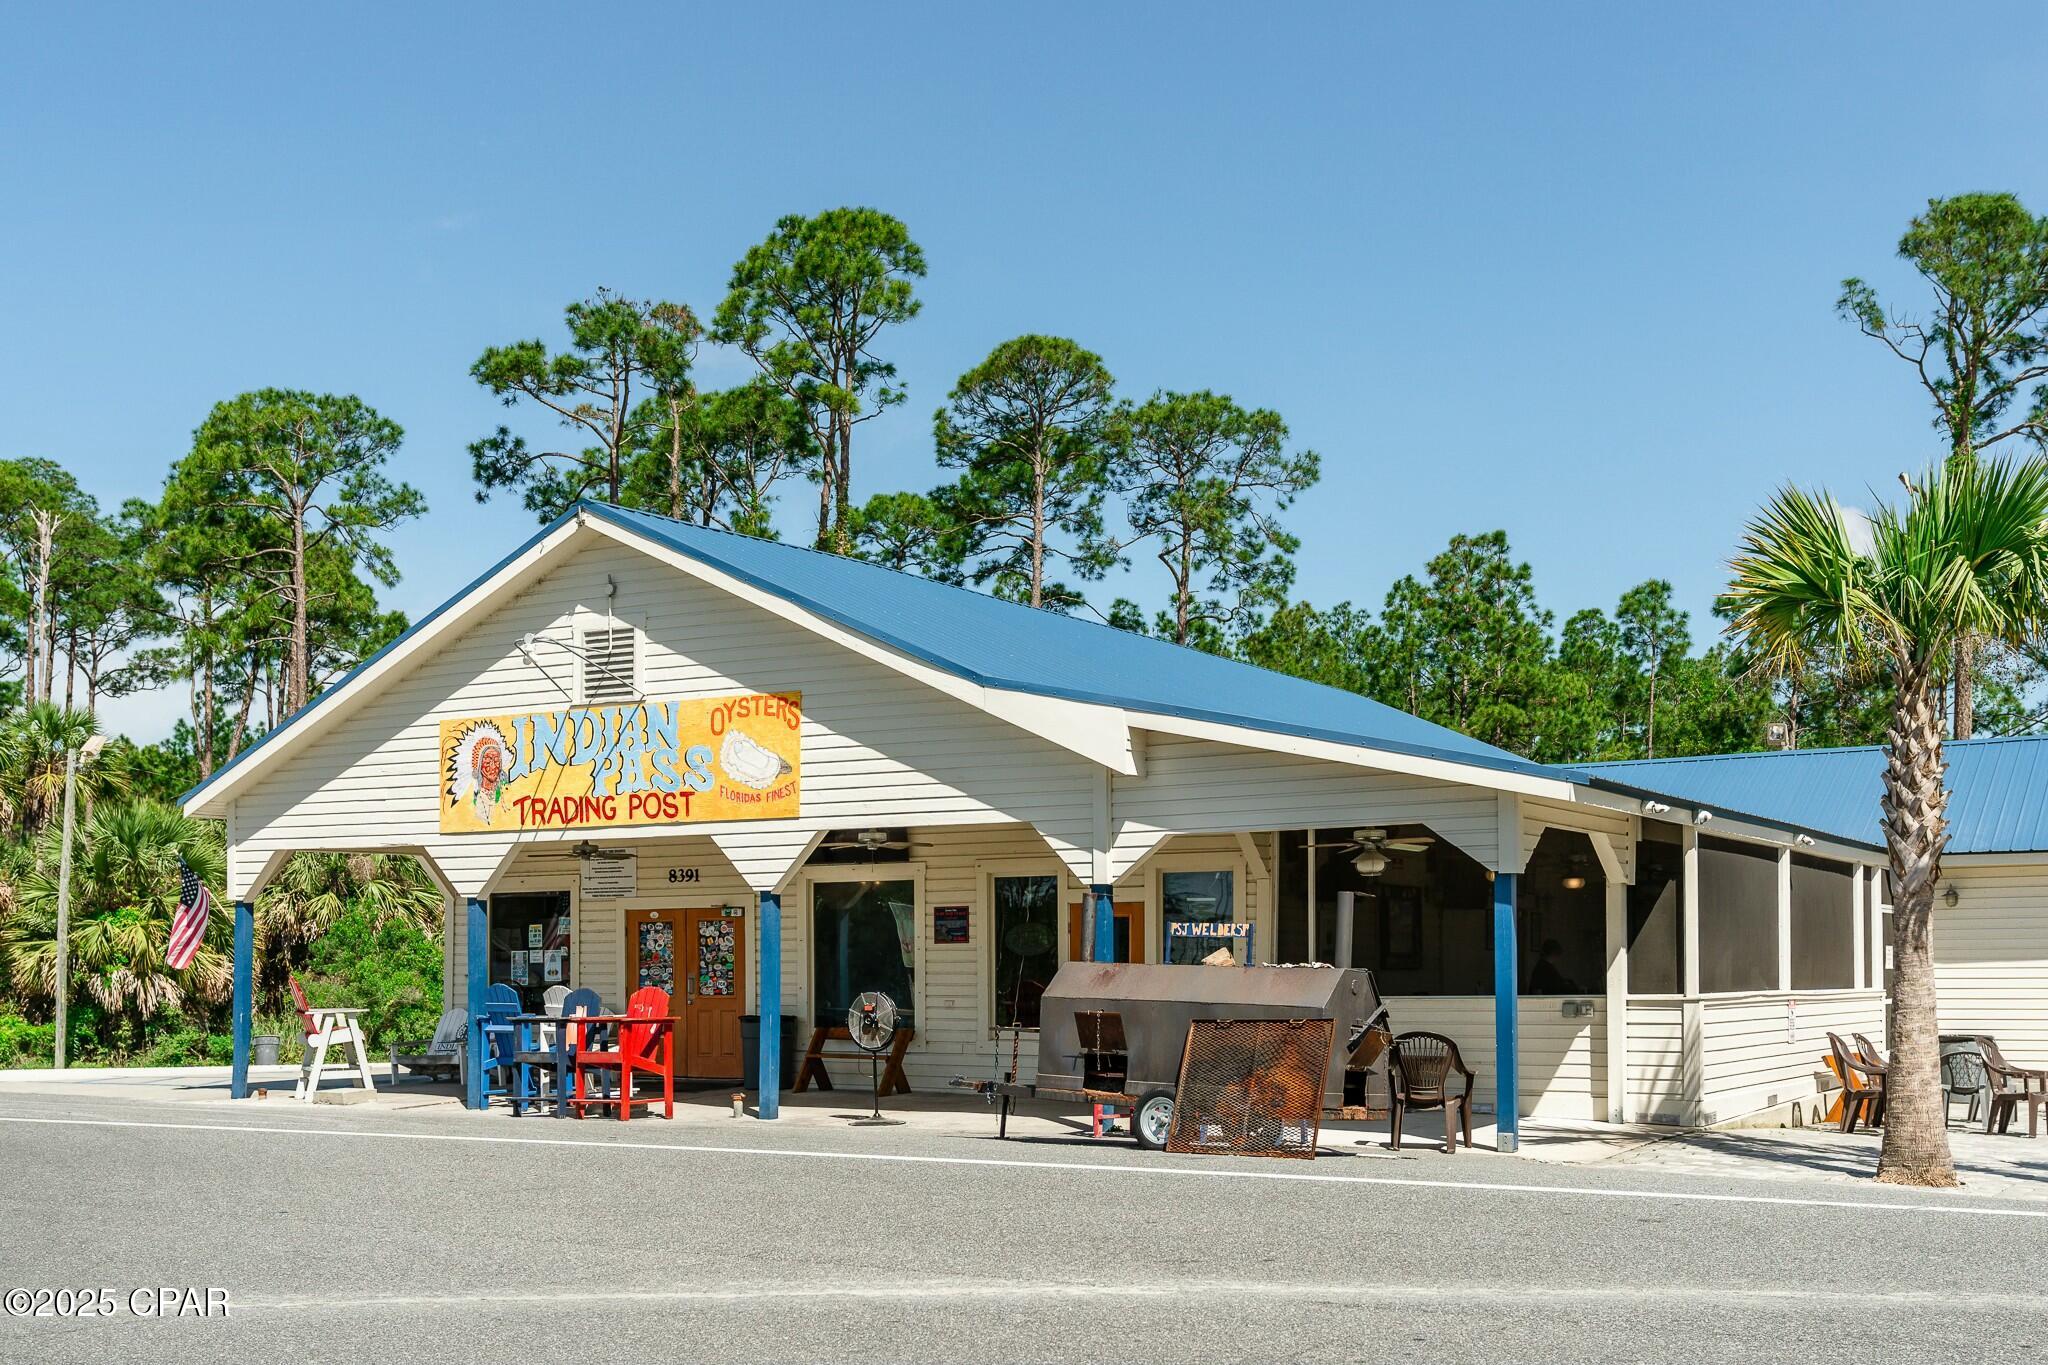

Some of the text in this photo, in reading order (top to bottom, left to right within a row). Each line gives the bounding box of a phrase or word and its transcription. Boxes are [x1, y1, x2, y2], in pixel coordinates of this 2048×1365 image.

[710, 695, 801, 736] OYSTERS
[508, 700, 681, 783] INDIAN
[590, 744, 715, 798] PASS
[513, 791, 696, 826] TRADING POST
[719, 780, 797, 804] FLORIDAS FINEST
[668, 868, 700, 883] 8391
